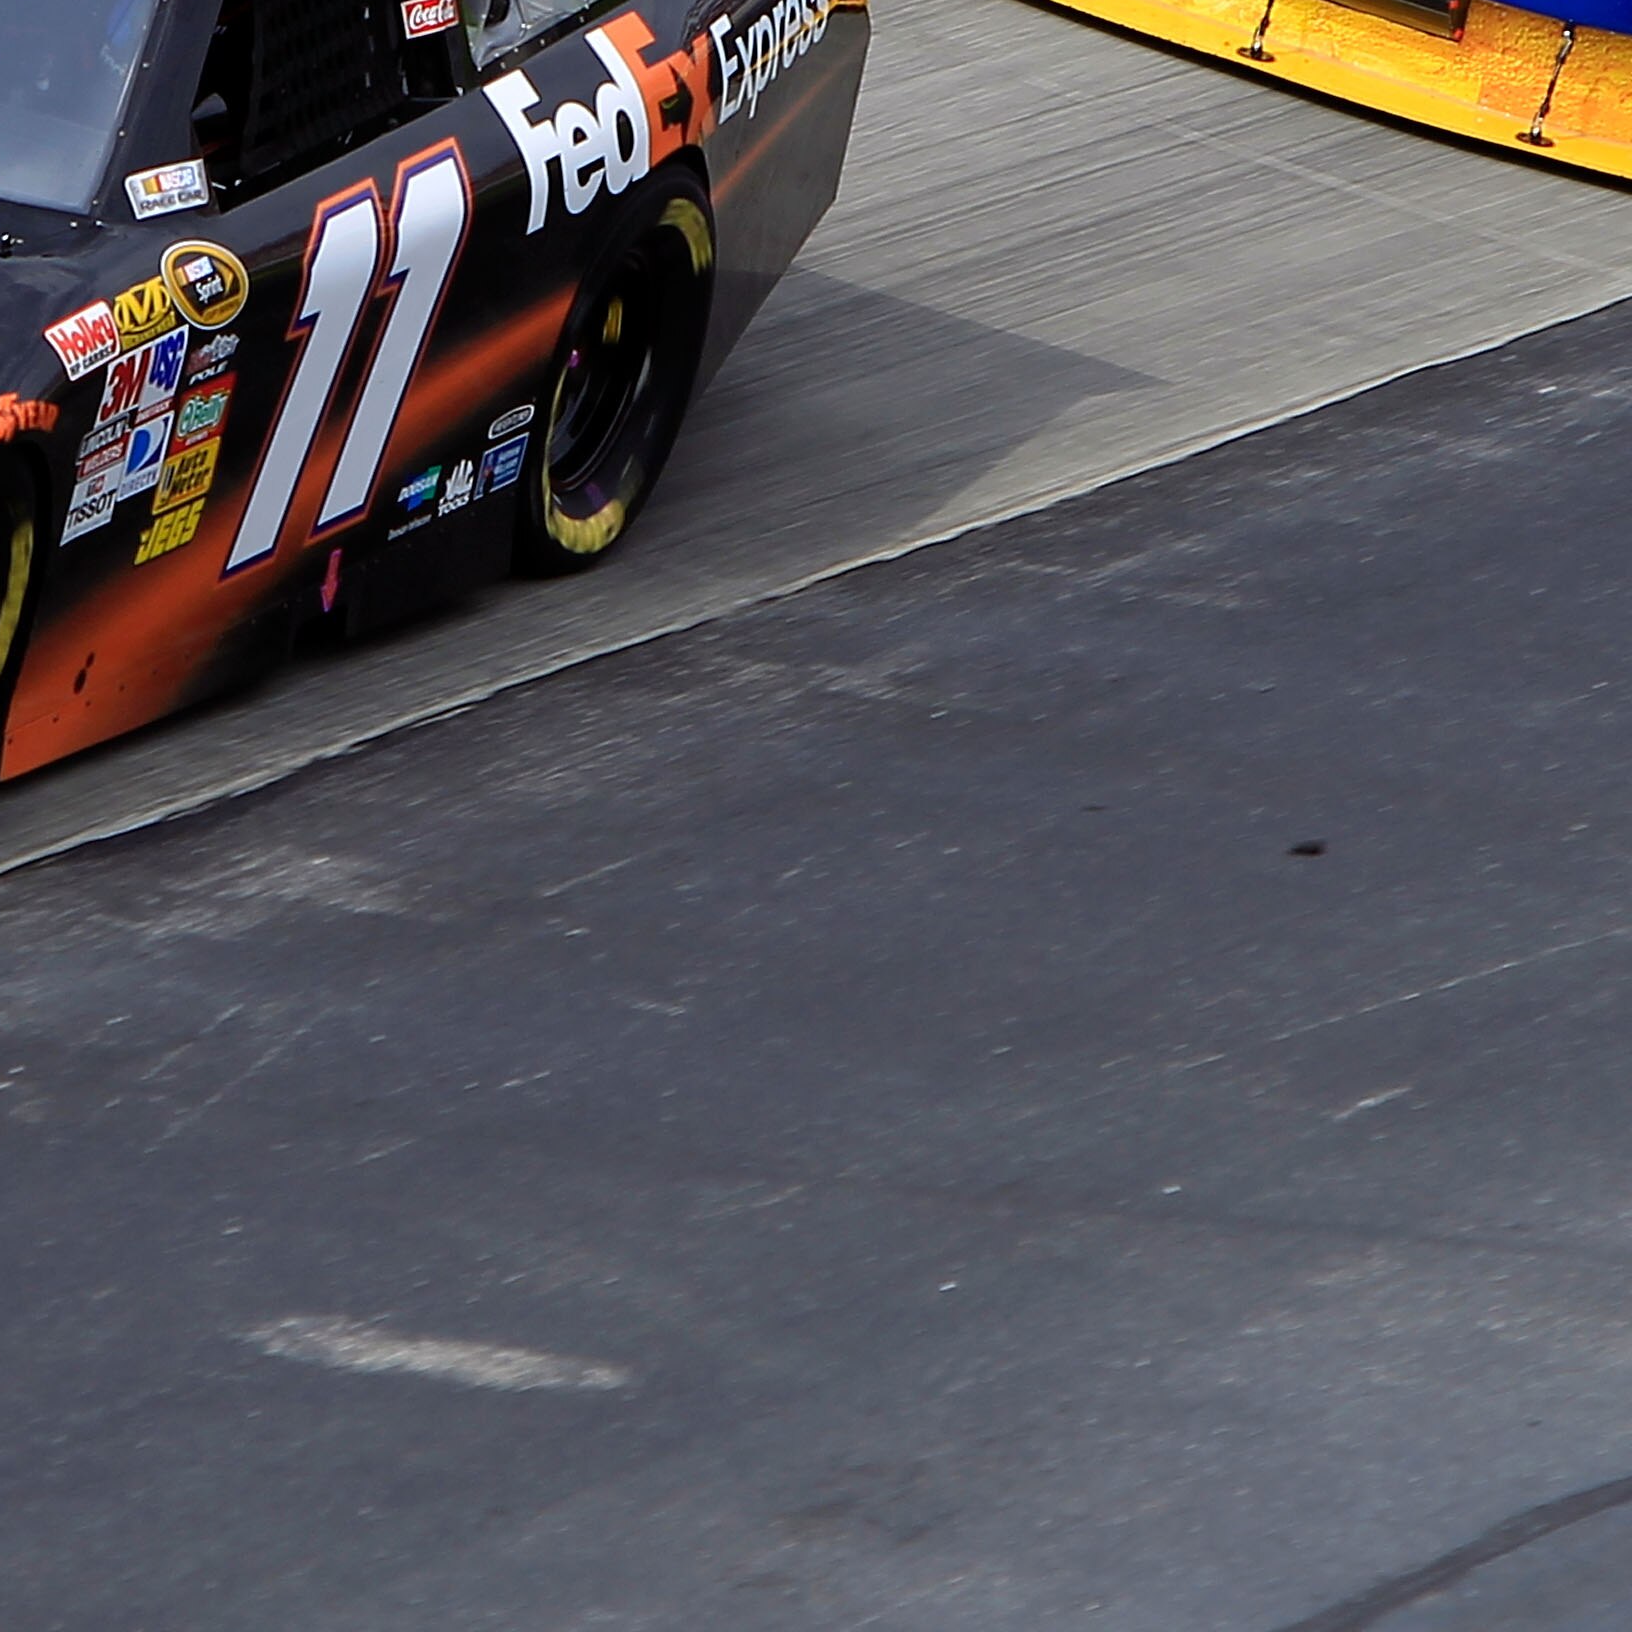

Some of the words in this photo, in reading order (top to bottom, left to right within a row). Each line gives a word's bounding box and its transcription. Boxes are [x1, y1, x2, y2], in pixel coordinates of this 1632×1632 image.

[482, 10, 717, 236] FedEx
[140, 195, 177, 211] RACE
[177, 189, 204, 205] CAR
[49, 312, 116, 365] Holley
[218, 137, 475, 582] 11
[99, 346, 152, 422] 3M
[189, 360, 229, 386] POLE
[178, 448, 208, 476] Auto
[67, 488, 118, 528] TISSOT
[135, 498, 208, 565] JEGS
